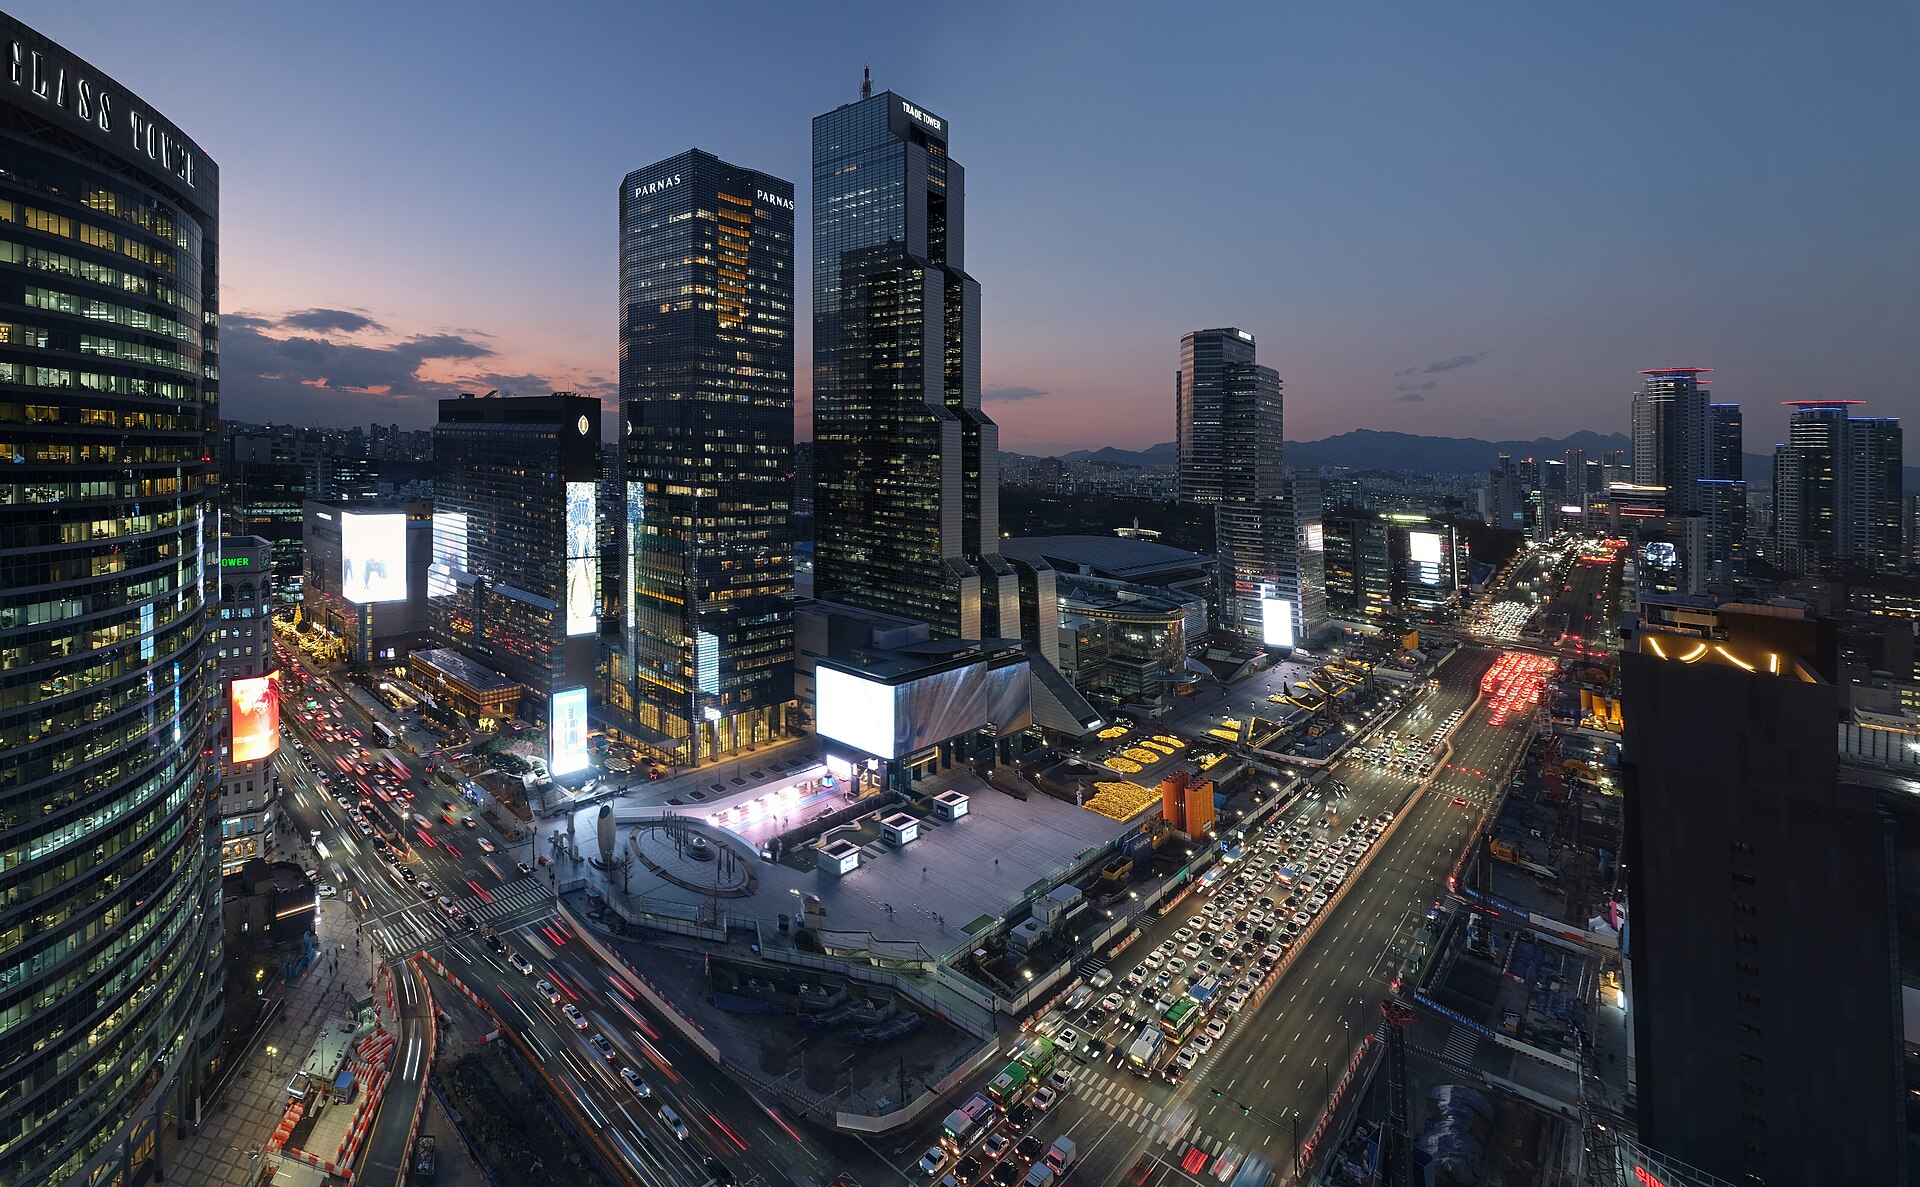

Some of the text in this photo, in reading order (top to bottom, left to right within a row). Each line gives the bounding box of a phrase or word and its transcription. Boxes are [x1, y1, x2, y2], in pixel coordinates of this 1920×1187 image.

[7, 40, 196, 188] GLASS TOWER
[901, 101, 942, 131] TRADE TOWER
[634, 173, 682, 198] PARNAS
[756, 189, 795, 211] PARNAS
